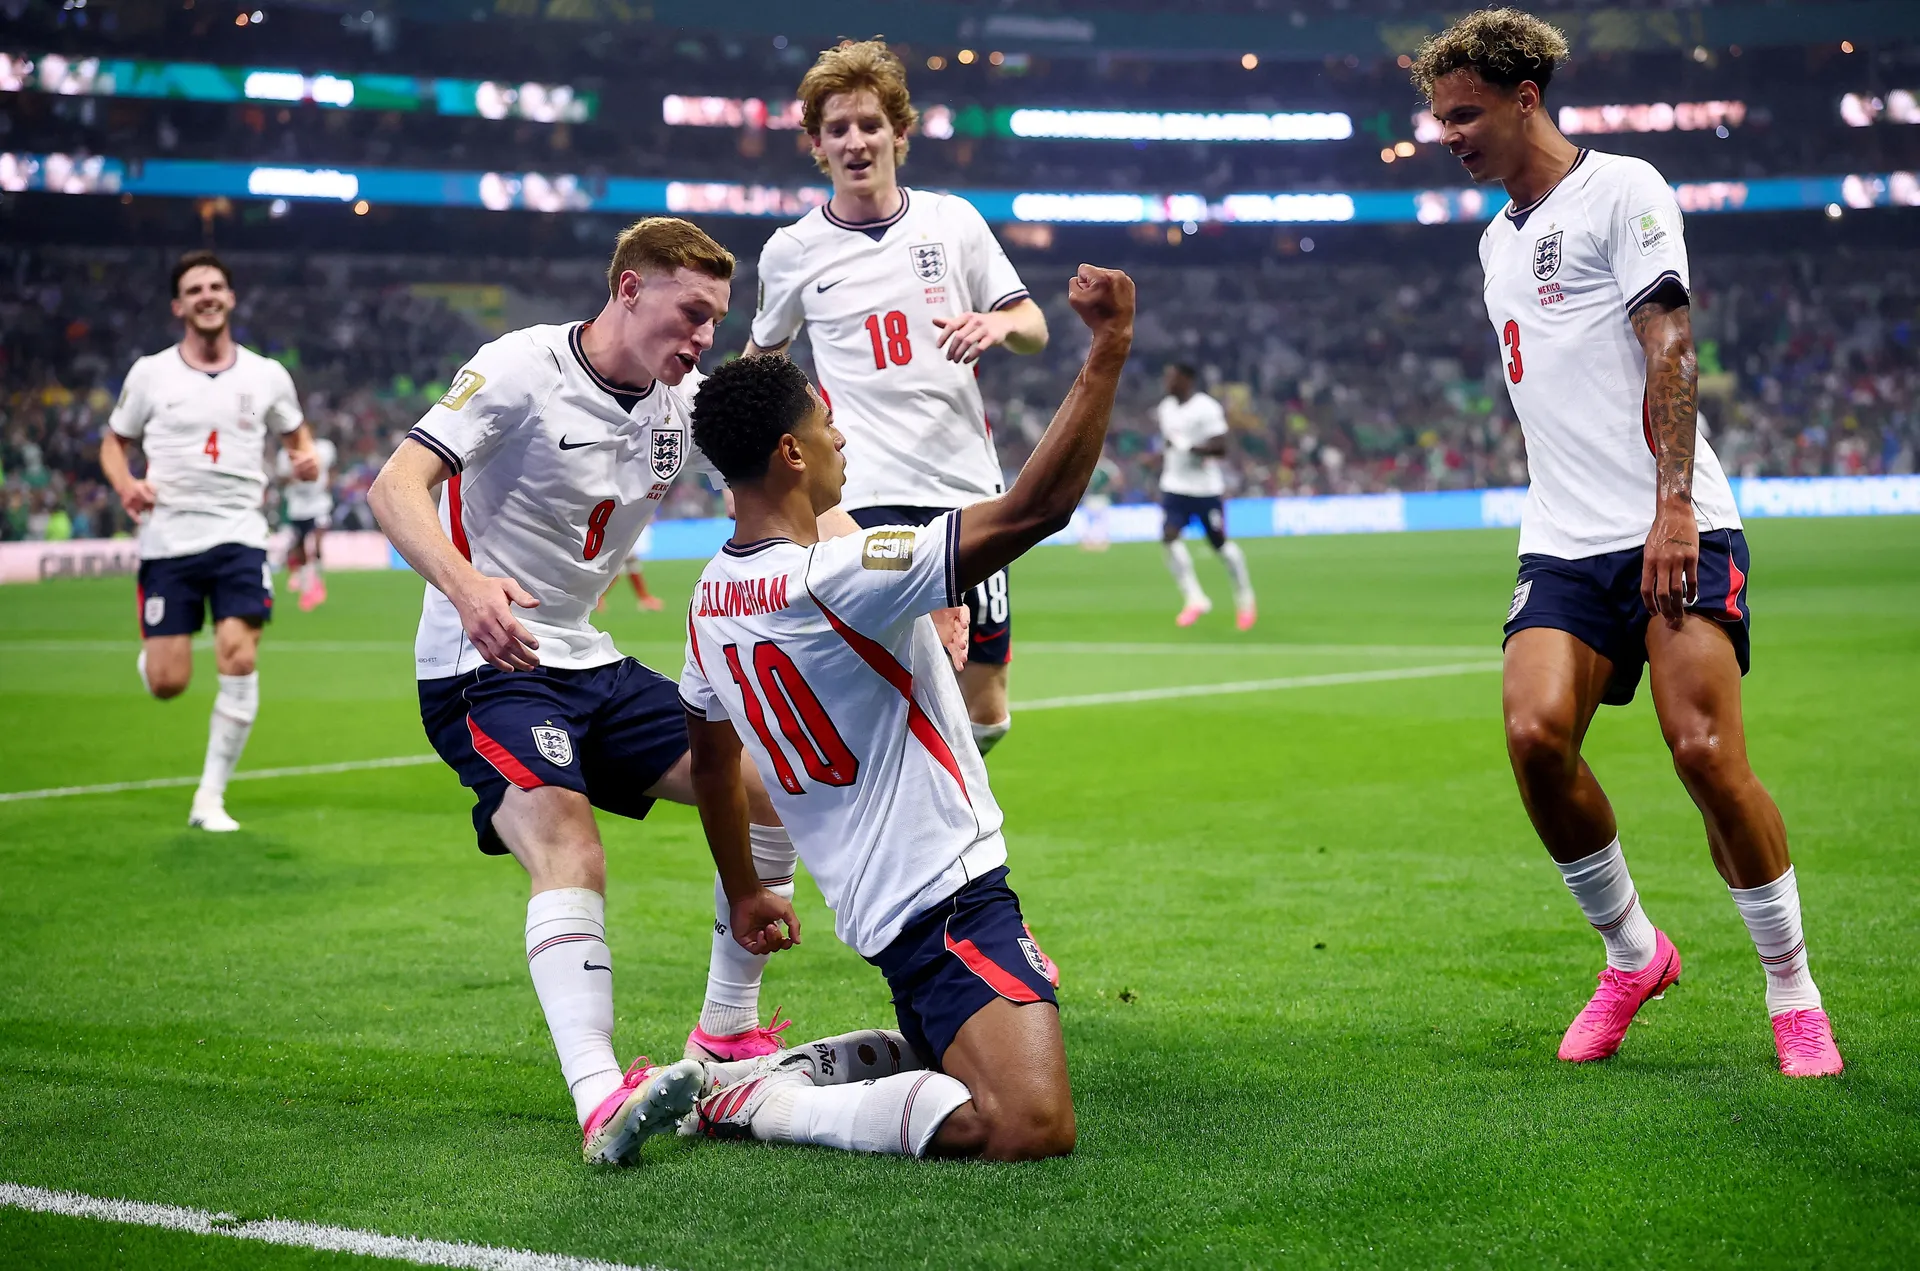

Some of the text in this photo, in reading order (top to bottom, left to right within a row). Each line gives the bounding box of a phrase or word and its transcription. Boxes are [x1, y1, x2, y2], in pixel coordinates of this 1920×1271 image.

[1537, 282, 1561, 295] MEXICO
[1540, 293, 1565, 306] 05.07.26
[865, 310, 912, 370] 18
[1503, 319, 1524, 384] 3
[203, 427, 221, 464] 4
[582, 499, 616, 560] 8
[974, 569, 1009, 625] 18
[722, 639, 860, 795] 10
[715, 918, 728, 936] NG
[812, 1043, 834, 1076] ENG
